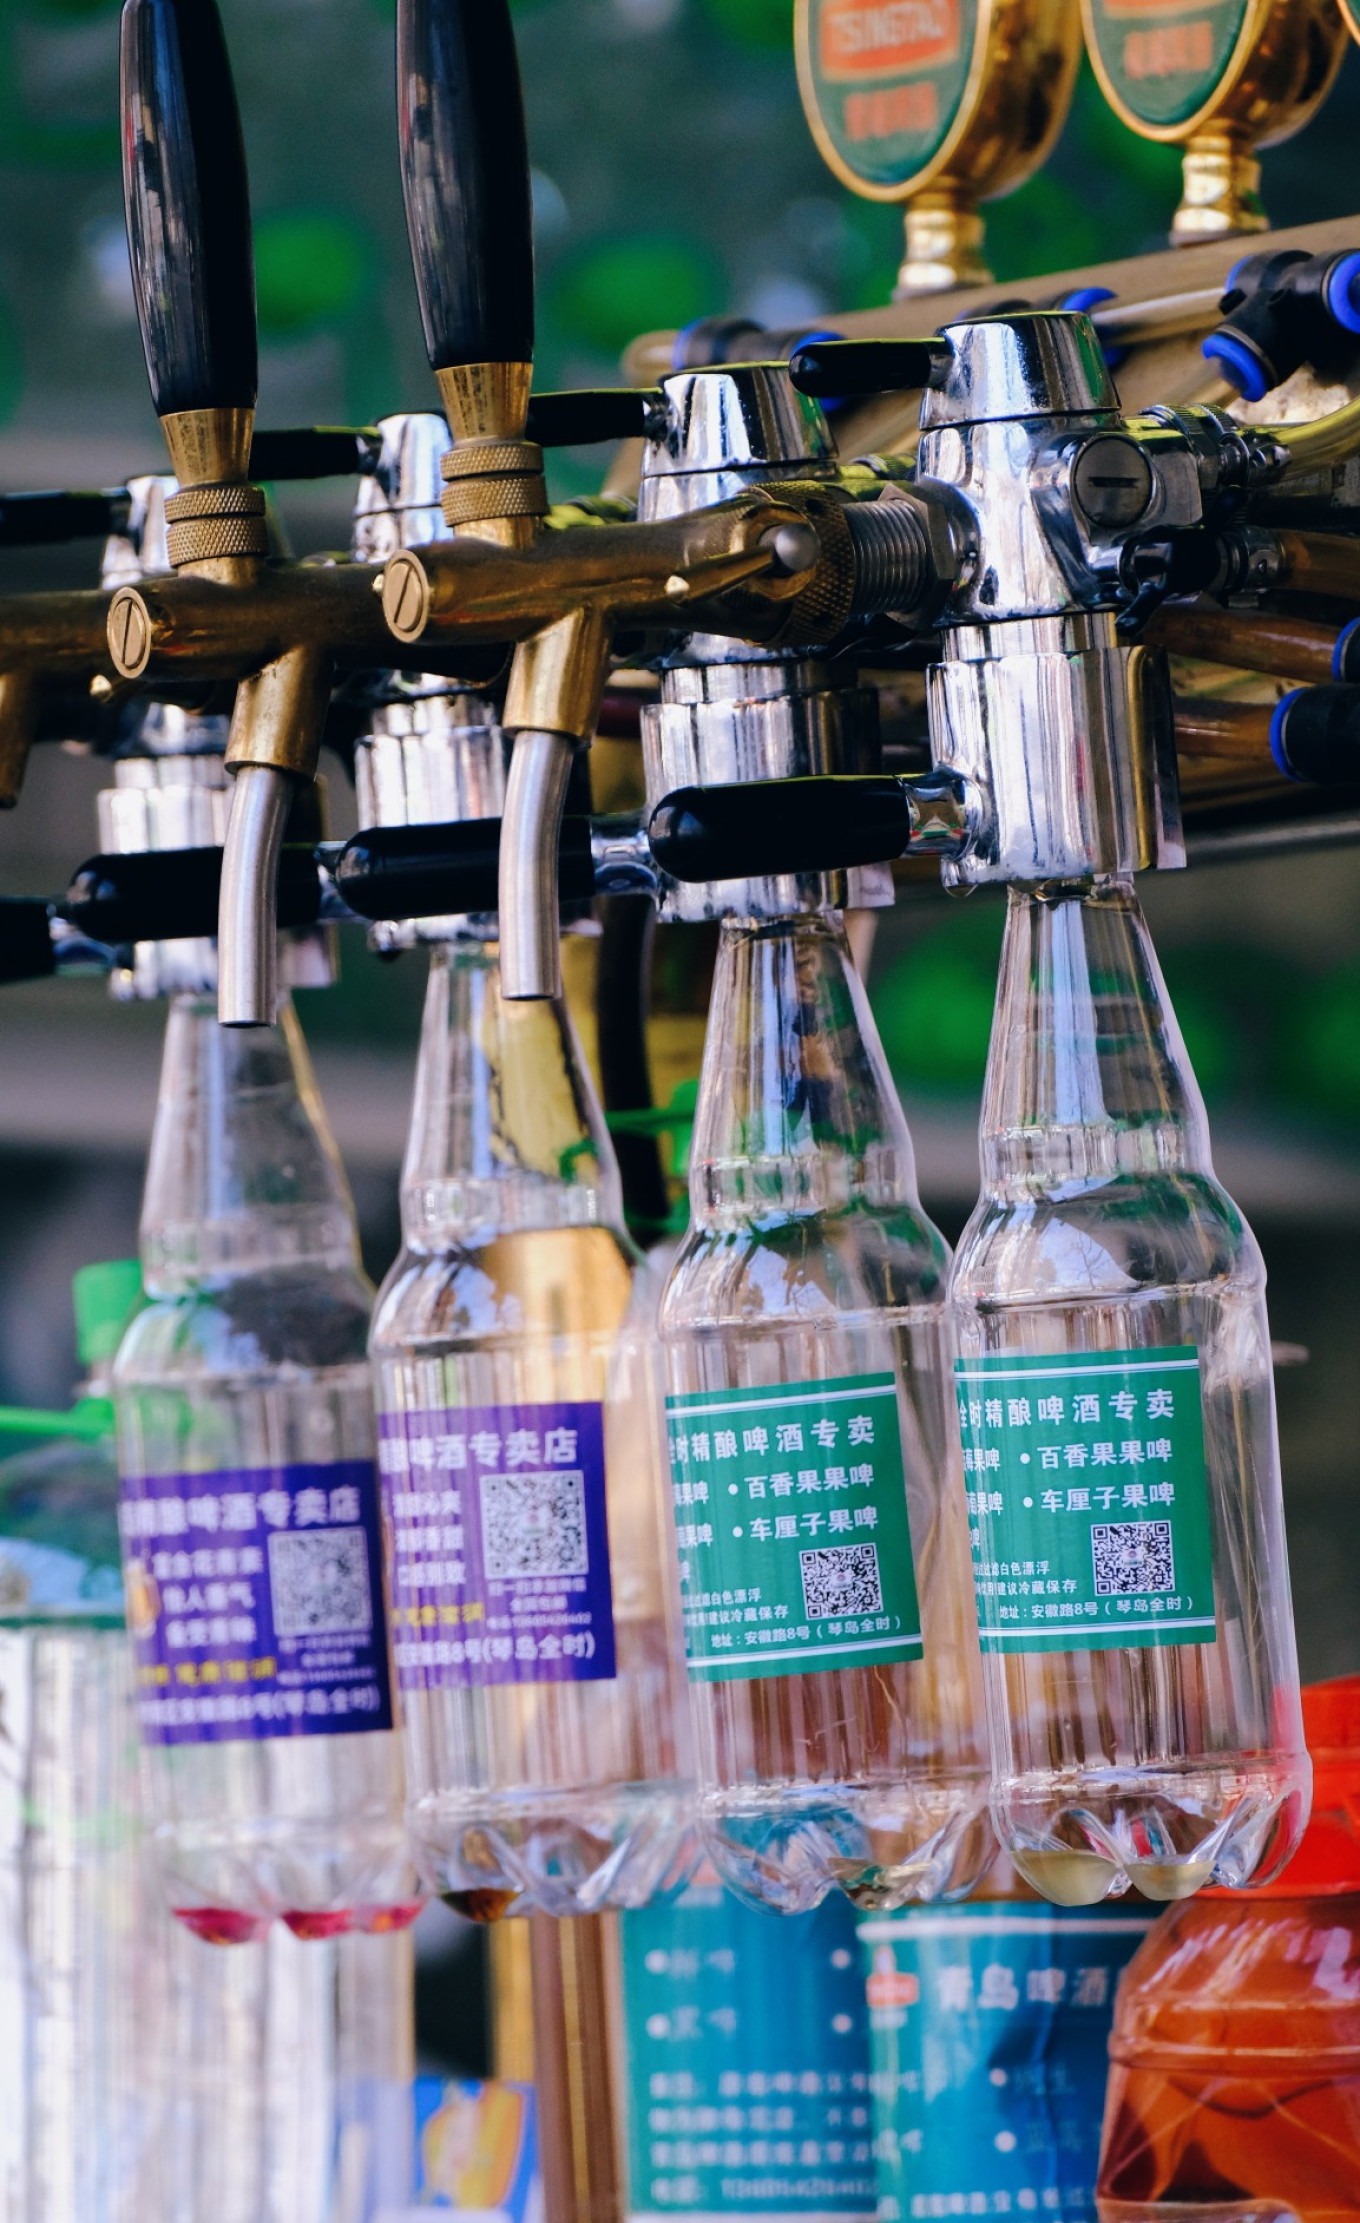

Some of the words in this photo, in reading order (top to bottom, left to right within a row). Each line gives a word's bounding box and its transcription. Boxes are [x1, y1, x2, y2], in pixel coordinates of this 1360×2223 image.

[1037, 1437, 1173, 1470] 百香果果啤
[744, 1462, 875, 1500] 百香果果啤
[1040, 1481, 1176, 1514] 车厘子果啤
[749, 1505, 879, 1542] 车厘子果啤
